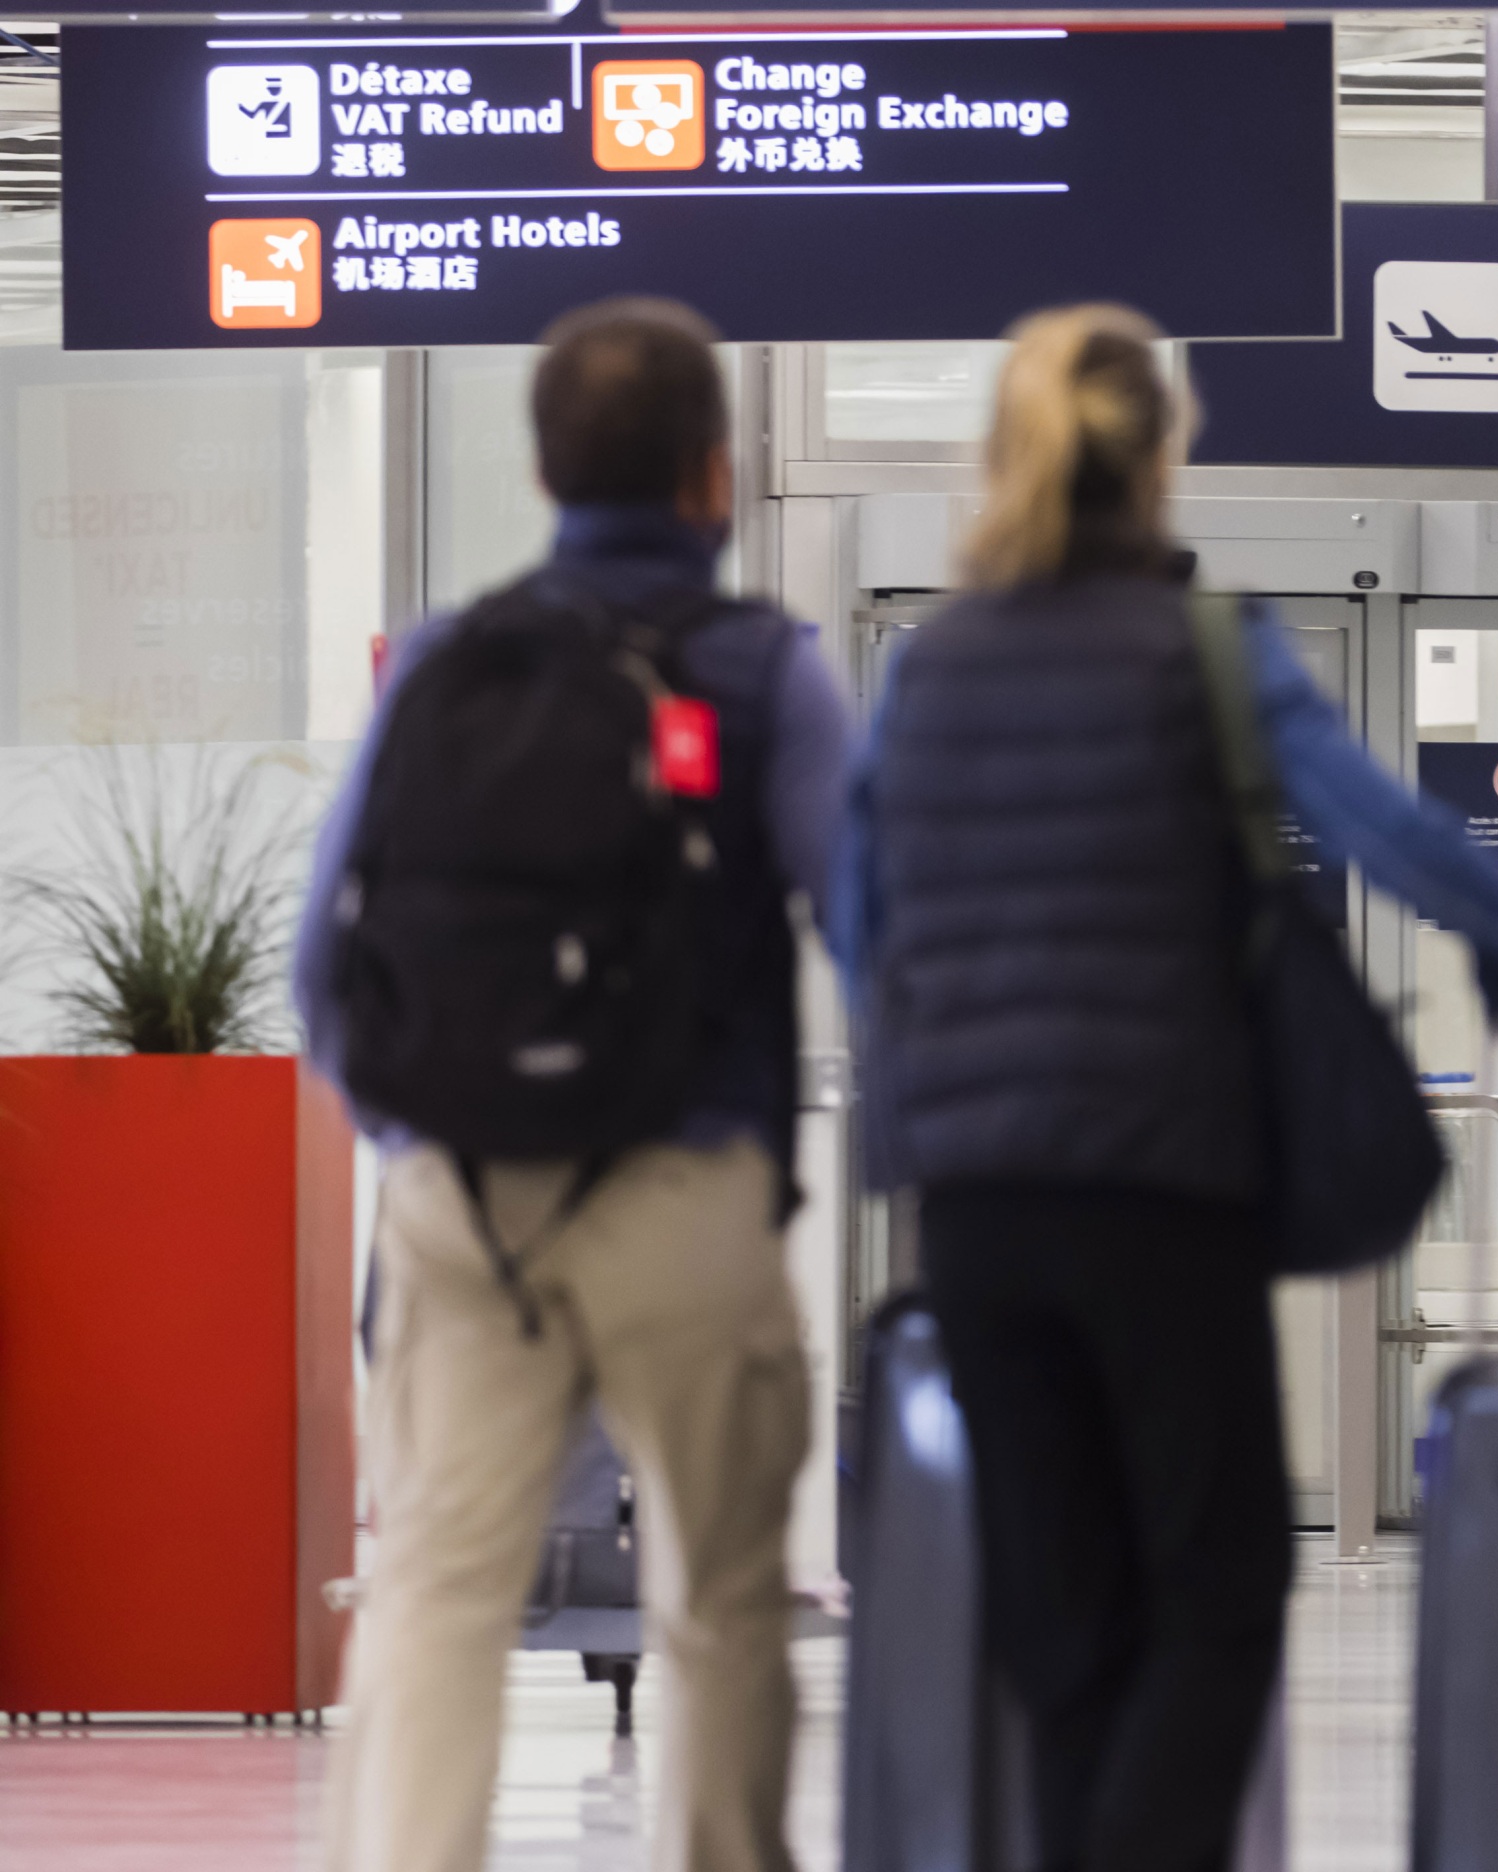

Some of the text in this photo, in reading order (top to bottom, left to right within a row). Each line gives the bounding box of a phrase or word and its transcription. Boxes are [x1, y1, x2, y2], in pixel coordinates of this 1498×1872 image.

[329, 61, 473, 97] Détaxe
[714, 56, 867, 97] Change
[330, 99, 564, 136] VAT Refund
[714, 94, 1069, 136] Foreign Exchange
[330, 142, 407, 178] 退税
[715, 137, 864, 173] 外币兑换
[332, 211, 621, 253] Airport Hotels
[331, 254, 479, 292] 机场酒店
